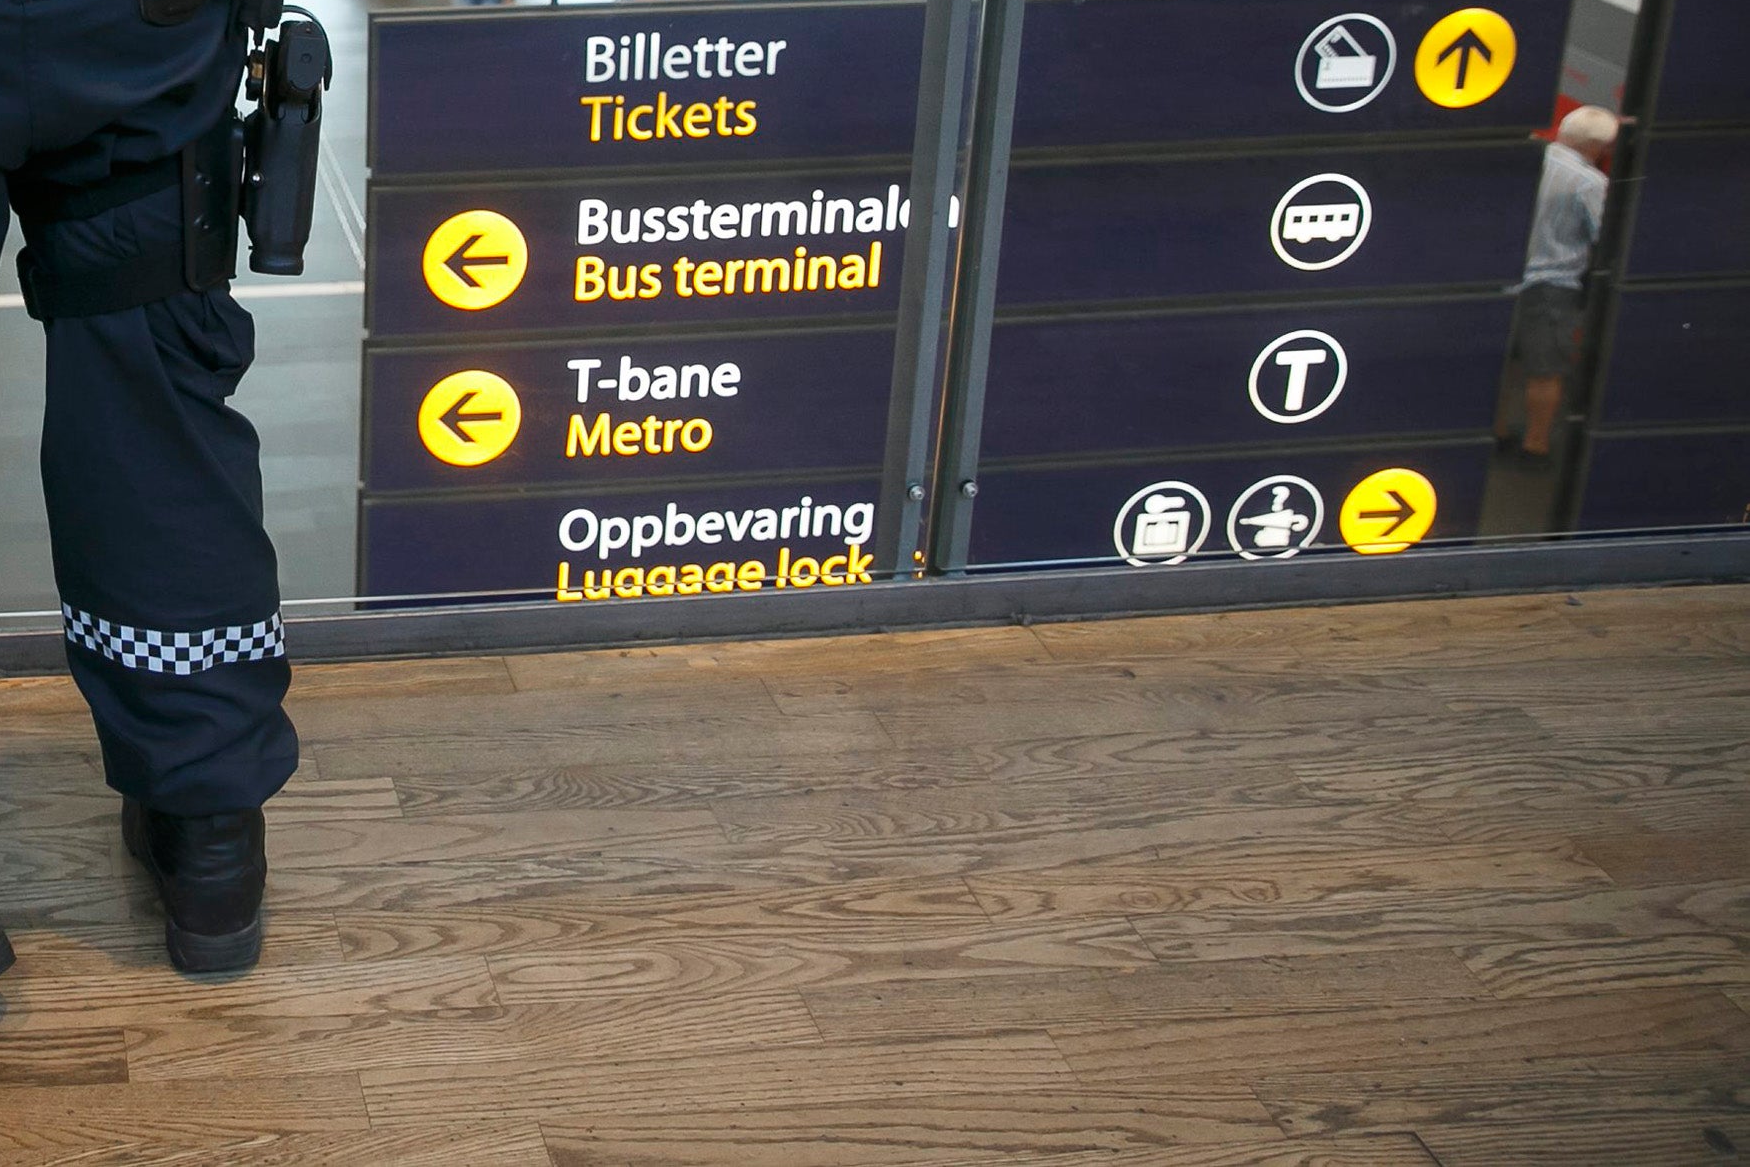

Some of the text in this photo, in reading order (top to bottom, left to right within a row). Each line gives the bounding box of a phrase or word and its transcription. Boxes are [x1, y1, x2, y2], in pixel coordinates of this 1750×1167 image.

[585, 32, 787, 83] Billetter
[580, 92, 758, 142] Tickets
[577, 185, 960, 246] Bussterminal
[573, 240, 883, 303] Bus terminal
[566, 355, 742, 403] T-bane
[565, 412, 713, 458] Metro
[558, 495, 875, 559] Oppbevaring
[556, 559, 767, 603] Luggage
